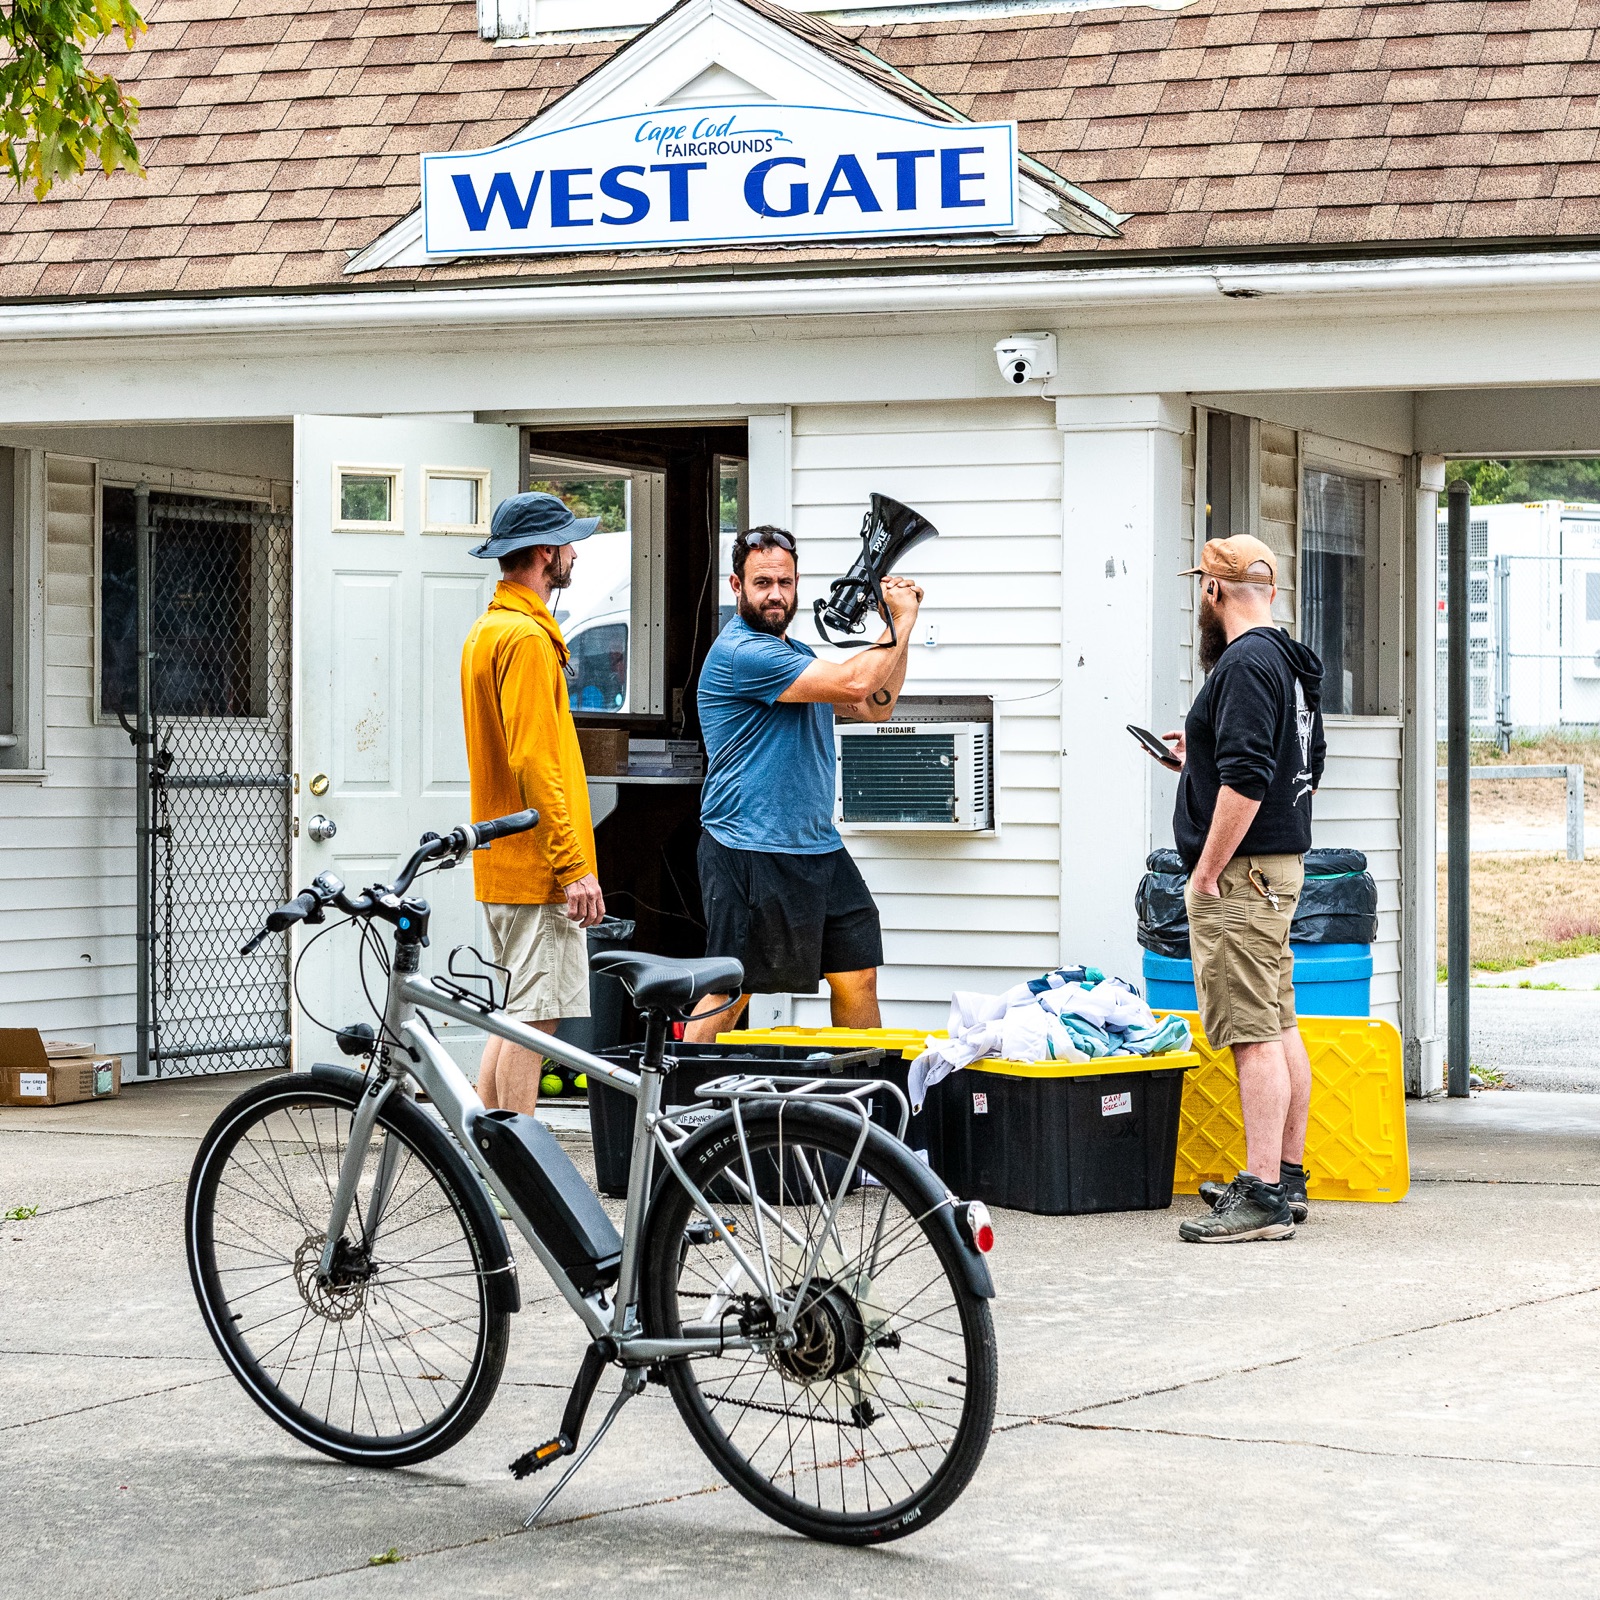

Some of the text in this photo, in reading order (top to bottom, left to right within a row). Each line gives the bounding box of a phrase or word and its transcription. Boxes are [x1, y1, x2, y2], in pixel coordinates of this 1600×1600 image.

[634, 115, 737, 155] Cape Cod
[665, 138, 773, 157] FAIRGROUNDS
[451, 146, 985, 231] WEST GATE
[872, 530, 888, 552] PYLE
[876, 726, 916, 734] FRIGIDAIRE
[902, 1507, 922, 1525] VIDA
